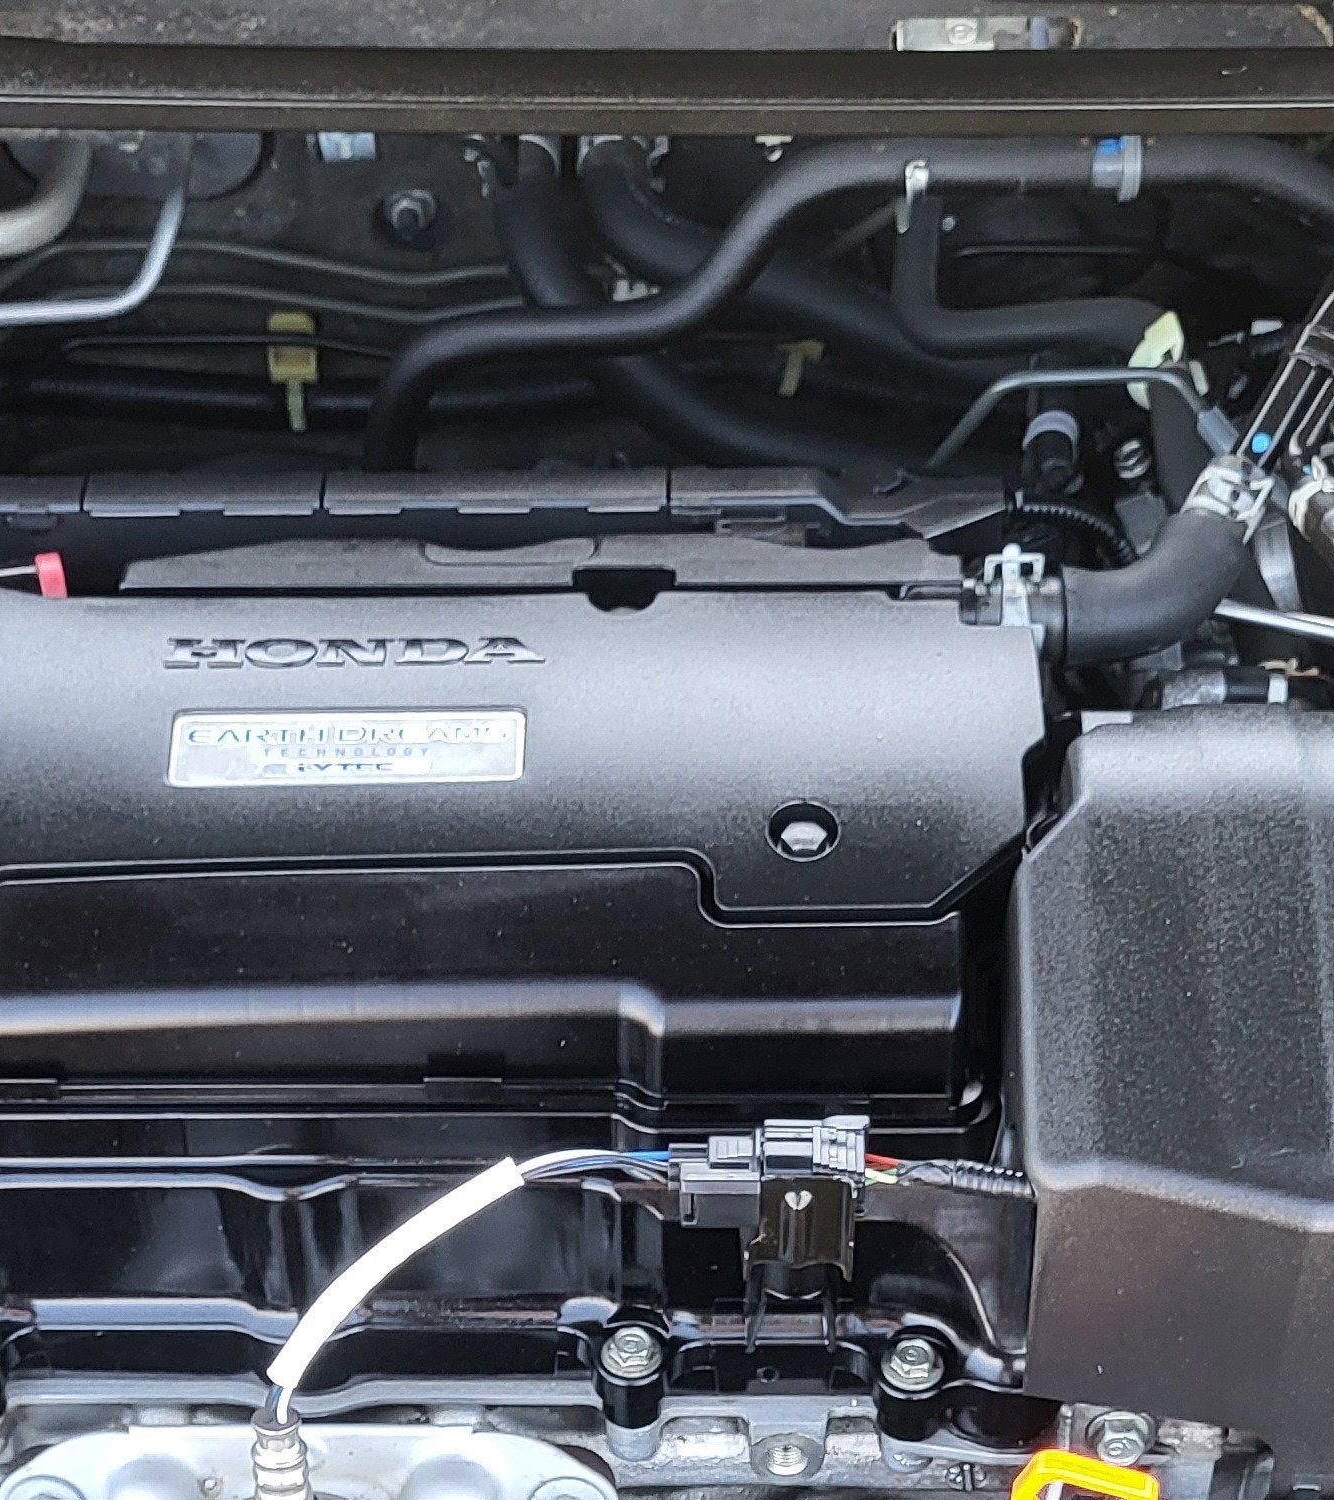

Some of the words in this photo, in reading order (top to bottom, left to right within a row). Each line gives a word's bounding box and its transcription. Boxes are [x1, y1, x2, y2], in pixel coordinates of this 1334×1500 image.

[163, 635, 547, 669] HONDA
[188, 728, 324, 744] EARTH
[264, 746, 430, 758] TECHNOLOGY
